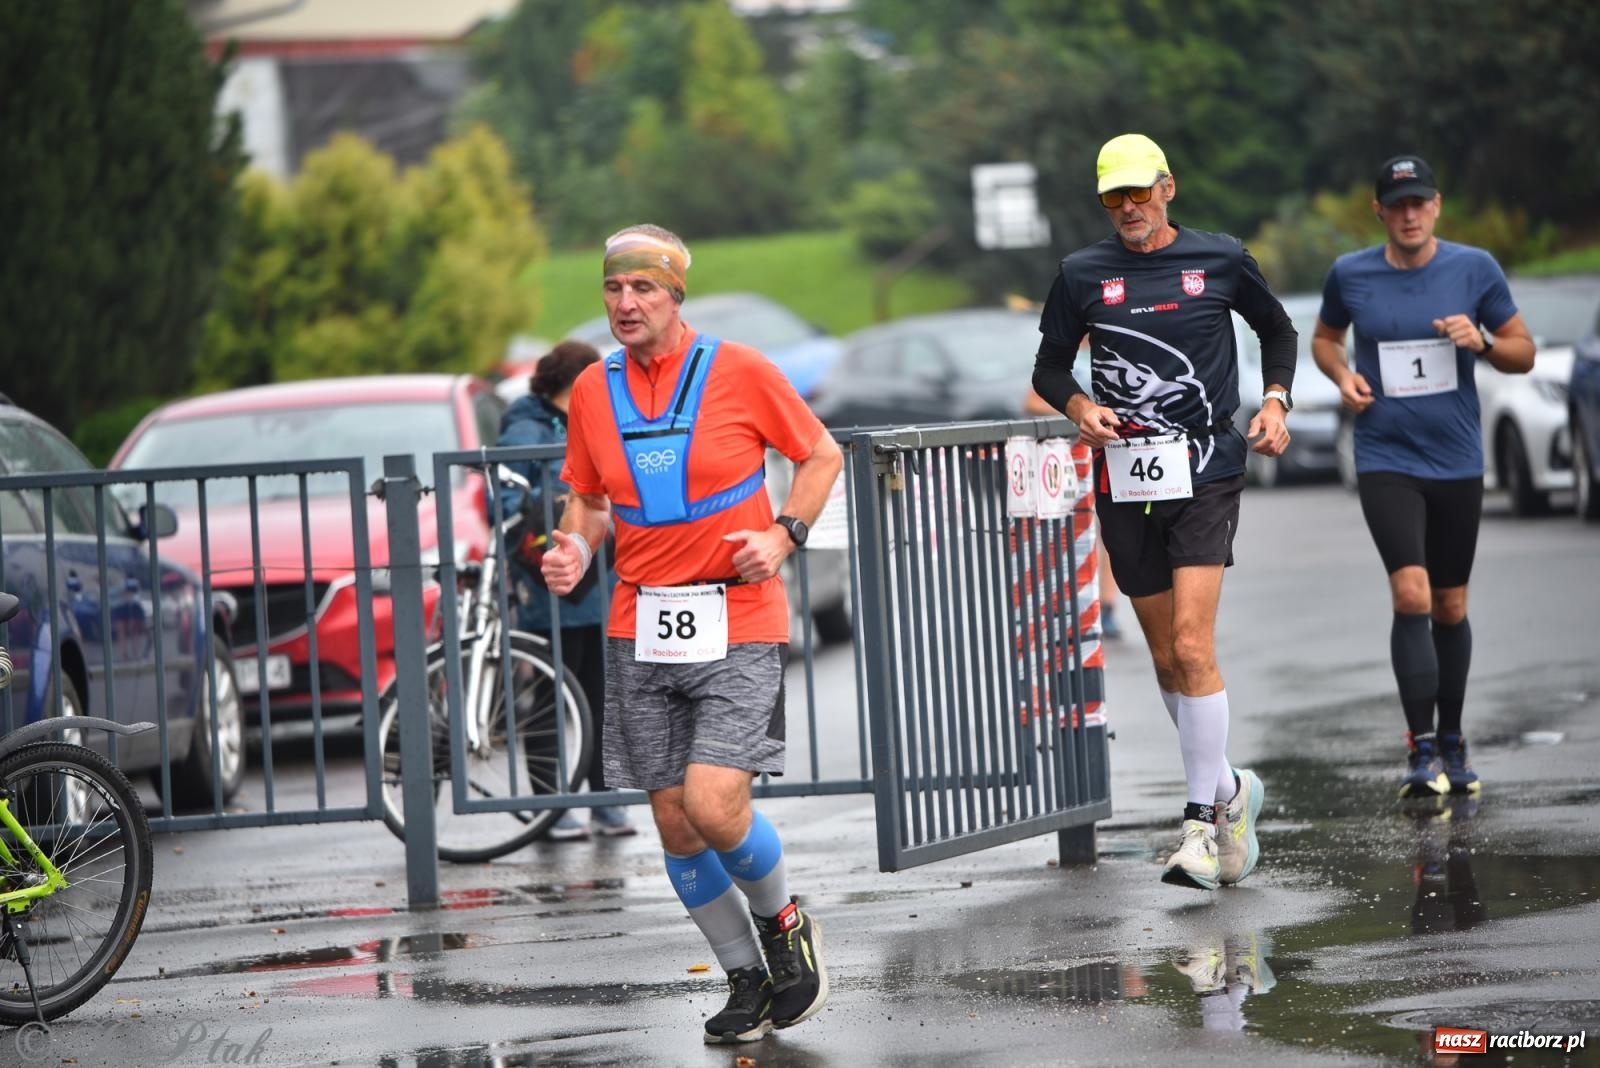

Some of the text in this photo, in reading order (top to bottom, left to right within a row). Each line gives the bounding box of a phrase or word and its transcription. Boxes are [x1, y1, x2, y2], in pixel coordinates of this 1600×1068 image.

[1412, 357, 1427, 379] 1
[1130, 456, 1164, 482] 46
[1128, 488, 1158, 497] Racibórz
[657, 610, 697, 640] 58
[652, 648, 688, 657] Racibórz
